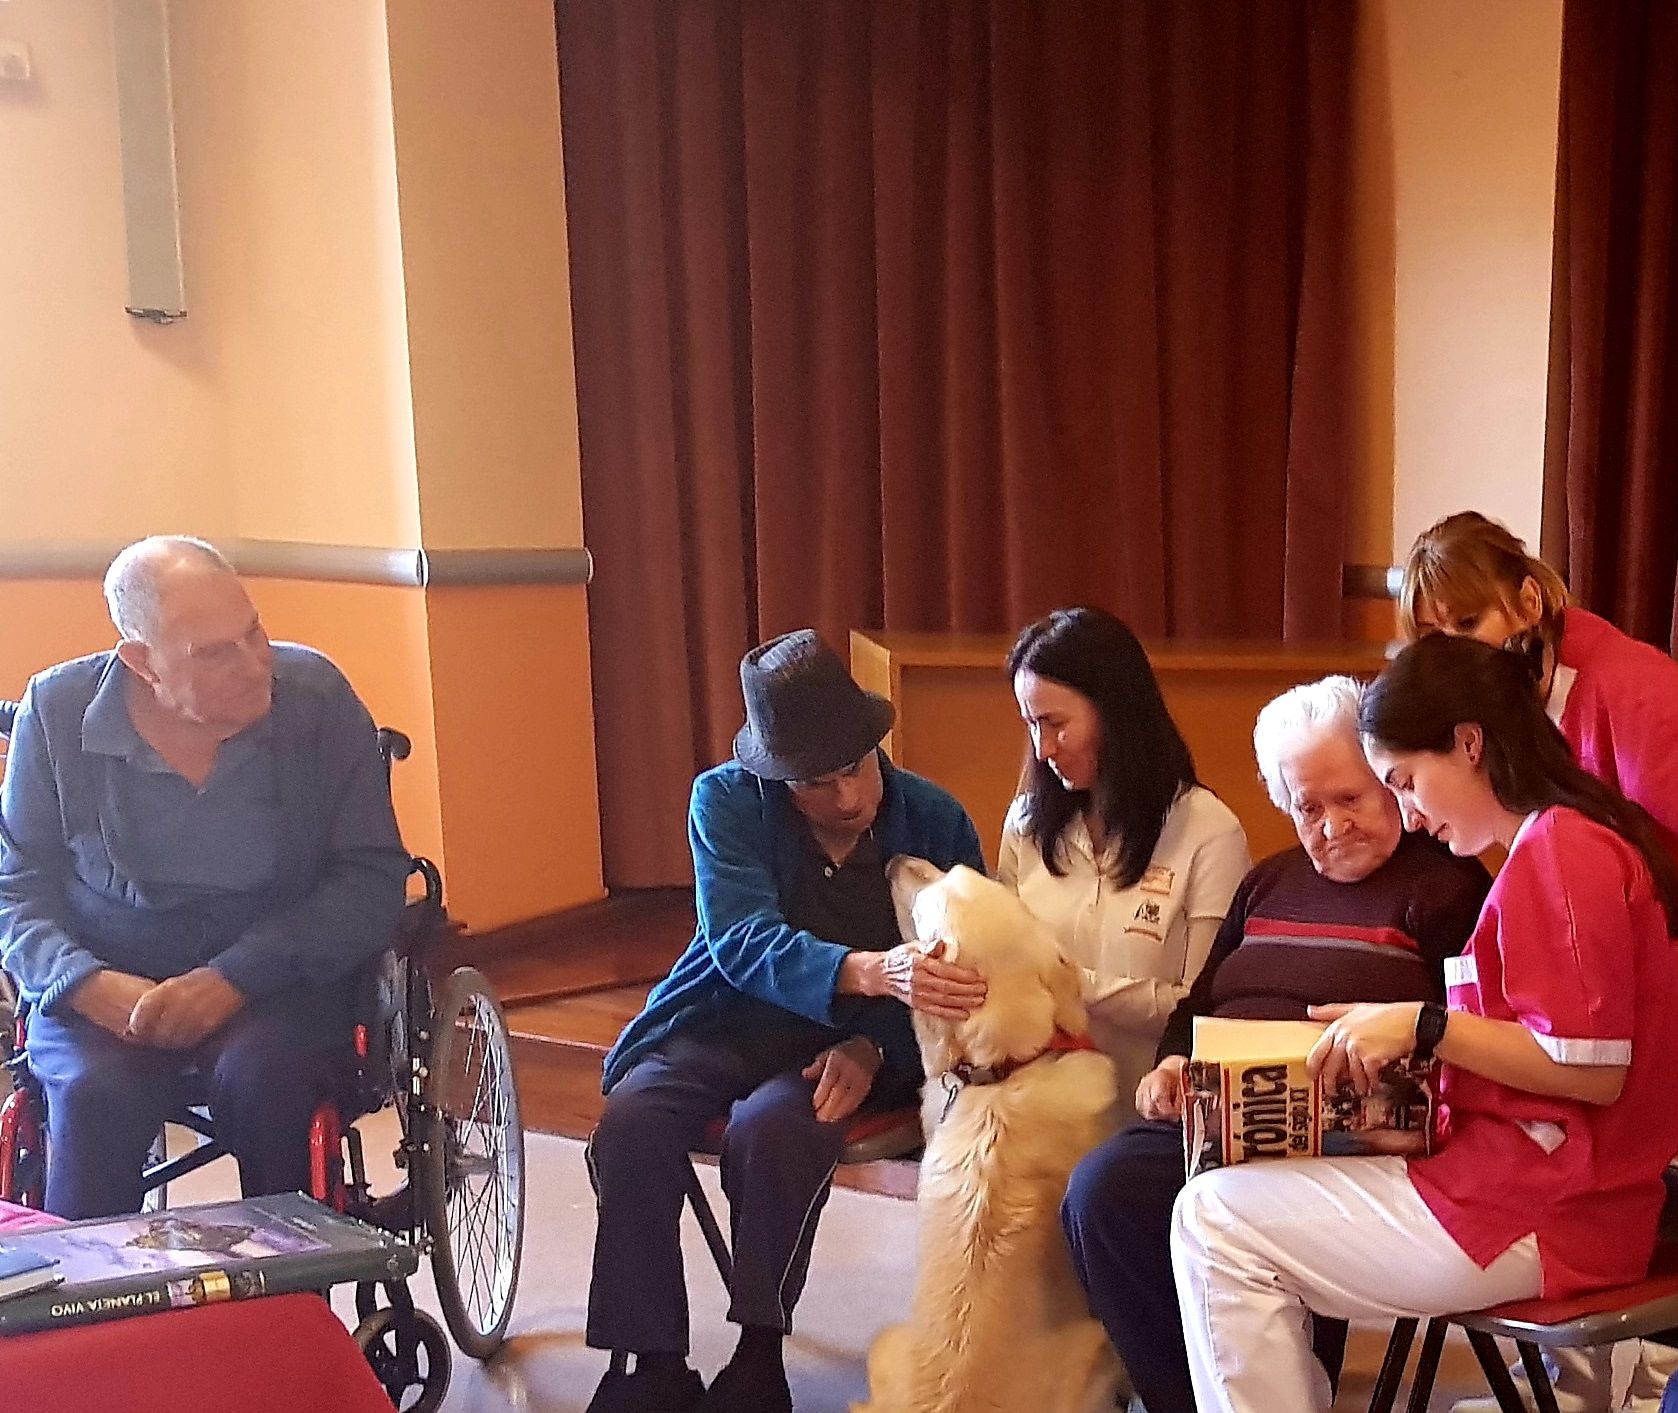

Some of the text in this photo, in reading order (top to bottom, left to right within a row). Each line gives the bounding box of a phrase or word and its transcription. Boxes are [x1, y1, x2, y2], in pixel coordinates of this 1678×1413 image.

[1233, 1064, 1288, 1161] rónica
[51, 1290, 161, 1318] EL PLANETA VIVO
